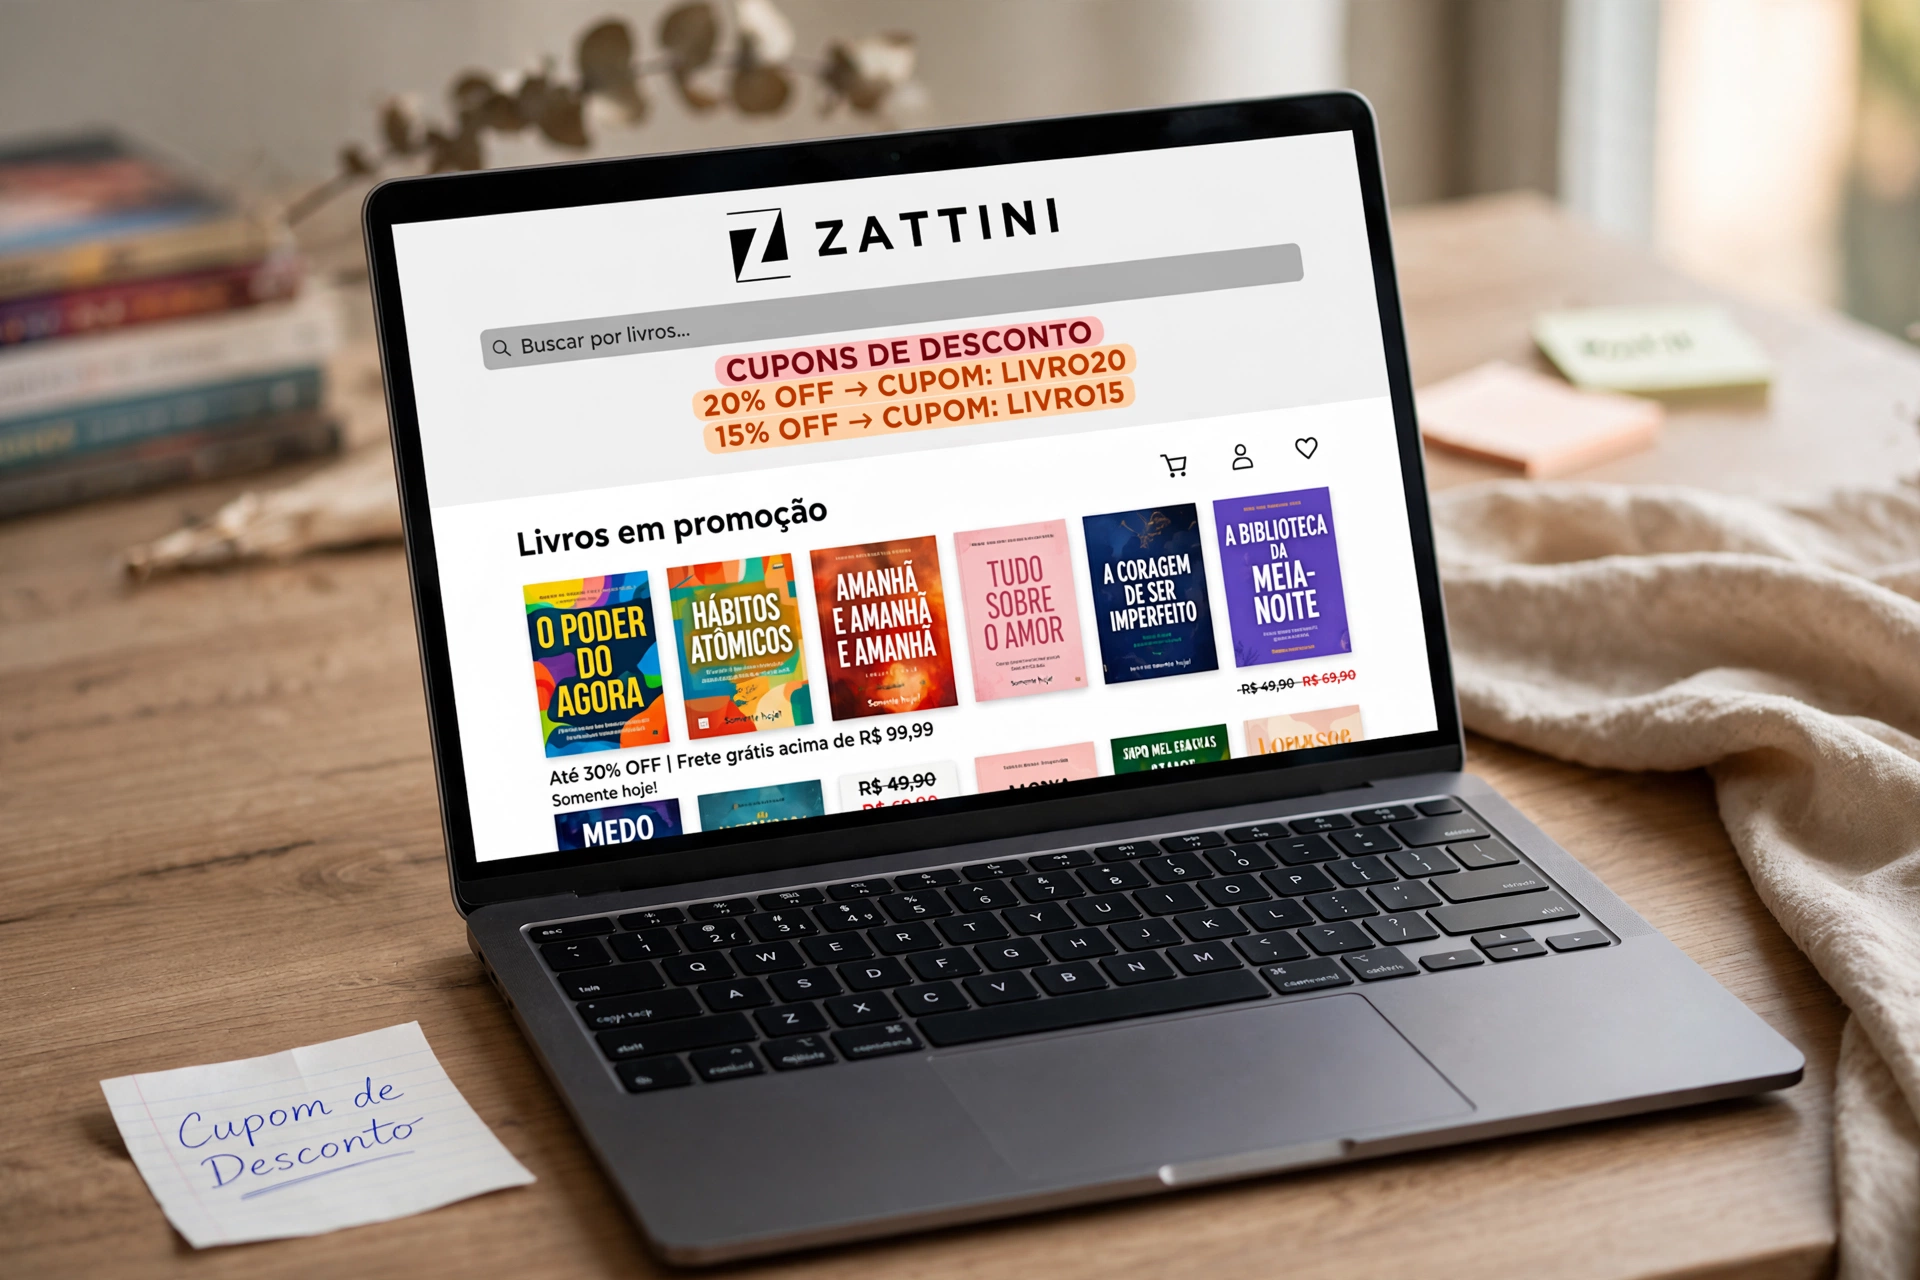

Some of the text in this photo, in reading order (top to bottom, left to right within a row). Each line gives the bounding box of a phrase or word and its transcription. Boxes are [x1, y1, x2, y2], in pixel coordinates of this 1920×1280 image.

[815, 198, 1060, 257] ZATTINI
[521, 326, 690, 354] Buscar por livros...
[726, 321, 1092, 382] CUPONS DE DESCONTO
[703, 349, 1126, 417] 20% OFF CUPOM: LIVRO20
[715, 381, 1125, 448] 15% OFF CUPOM: LIVRO15
[517, 497, 828, 557] Livros em promoção
[1225, 514, 1329, 546] A BIBLIOTECA
[1270, 542, 1288, 560] DA
[986, 555, 1043, 588] TUDO
[1104, 553, 1192, 585] A CORAGEM
[837, 559, 919, 601] AMANHÃ
[1252, 560, 1316, 593] MEIA-
[1124, 580, 1177, 606] DE SER
[986, 585, 1055, 619] SOBRE
[1254, 589, 1320, 625] NOITE
[691, 592, 781, 630] HÁBITOS
[832, 591, 933, 635] E AMANHÃ
[1110, 600, 1198, 632] IMPERFEITO
[536, 605, 647, 649] O PODER
[984, 616, 1065, 651] O AMOR
[691, 624, 794, 664] ATÔMICOS
[837, 624, 937, 668] E AMANHÃ
[576, 645, 613, 680] DO
[1260, 678, 1295, 693] 49,90
[1302, 674, 1319, 687] R$
[1321, 669, 1356, 684] 69,90
[557, 676, 645, 718] AGORA
[549, 767, 579, 786] Até
[584, 762, 621, 782] 30%
[626, 757, 662, 775] OFF
[677, 752, 722, 769] Frete
[726, 743, 774, 766] grátis
[779, 738, 829, 756] acima
[833, 732, 855, 749] de
[859, 727, 882, 745] R$
[886, 721, 934, 742] 99,99
[858, 772, 937, 796] R$ 49,90
[552, 781, 658, 807] Somente hoje!
[582, 814, 654, 848] MEDO
[1173, 867, 1186, 875] 9
[1289, 875, 1302, 885] P
[1044, 886, 1055, 894] 7
[1225, 885, 1241, 894] O
[979, 895, 992, 904] 6
[913, 904, 926, 914] 5
[1095, 903, 1112, 913] U
[1268, 910, 1284, 918] L
[847, 914, 859, 922] 4
[1029, 912, 1042, 922] Y
[778, 924, 791, 932] 3
[963, 922, 976, 931] T
[1202, 919, 1219, 929] K
[709, 934, 723, 943] 2
[896, 932, 912, 942] R
[1141, 928, 1151, 938] J
[828, 941, 843, 952] E
[1070, 938, 1087, 948] H
[755, 951, 776, 962] W
[1003, 948, 1020, 958] G
[1193, 952, 1214, 963] M
[689, 962, 707, 972] Q
[935, 958, 948, 968] F
[1127, 961, 1146, 972] N
[865, 968, 882, 979] D
[1060, 972, 1077, 983] B
[797, 978, 812, 988] S
[990, 981, 1005, 992] V
[729, 989, 744, 999] A
[923, 992, 939, 1003] C
[853, 1002, 871, 1013] X
[782, 1012, 799, 1024] Z
[178, 1076, 405, 1148] Cupom de
[200, 1117, 425, 1189] Desconto
